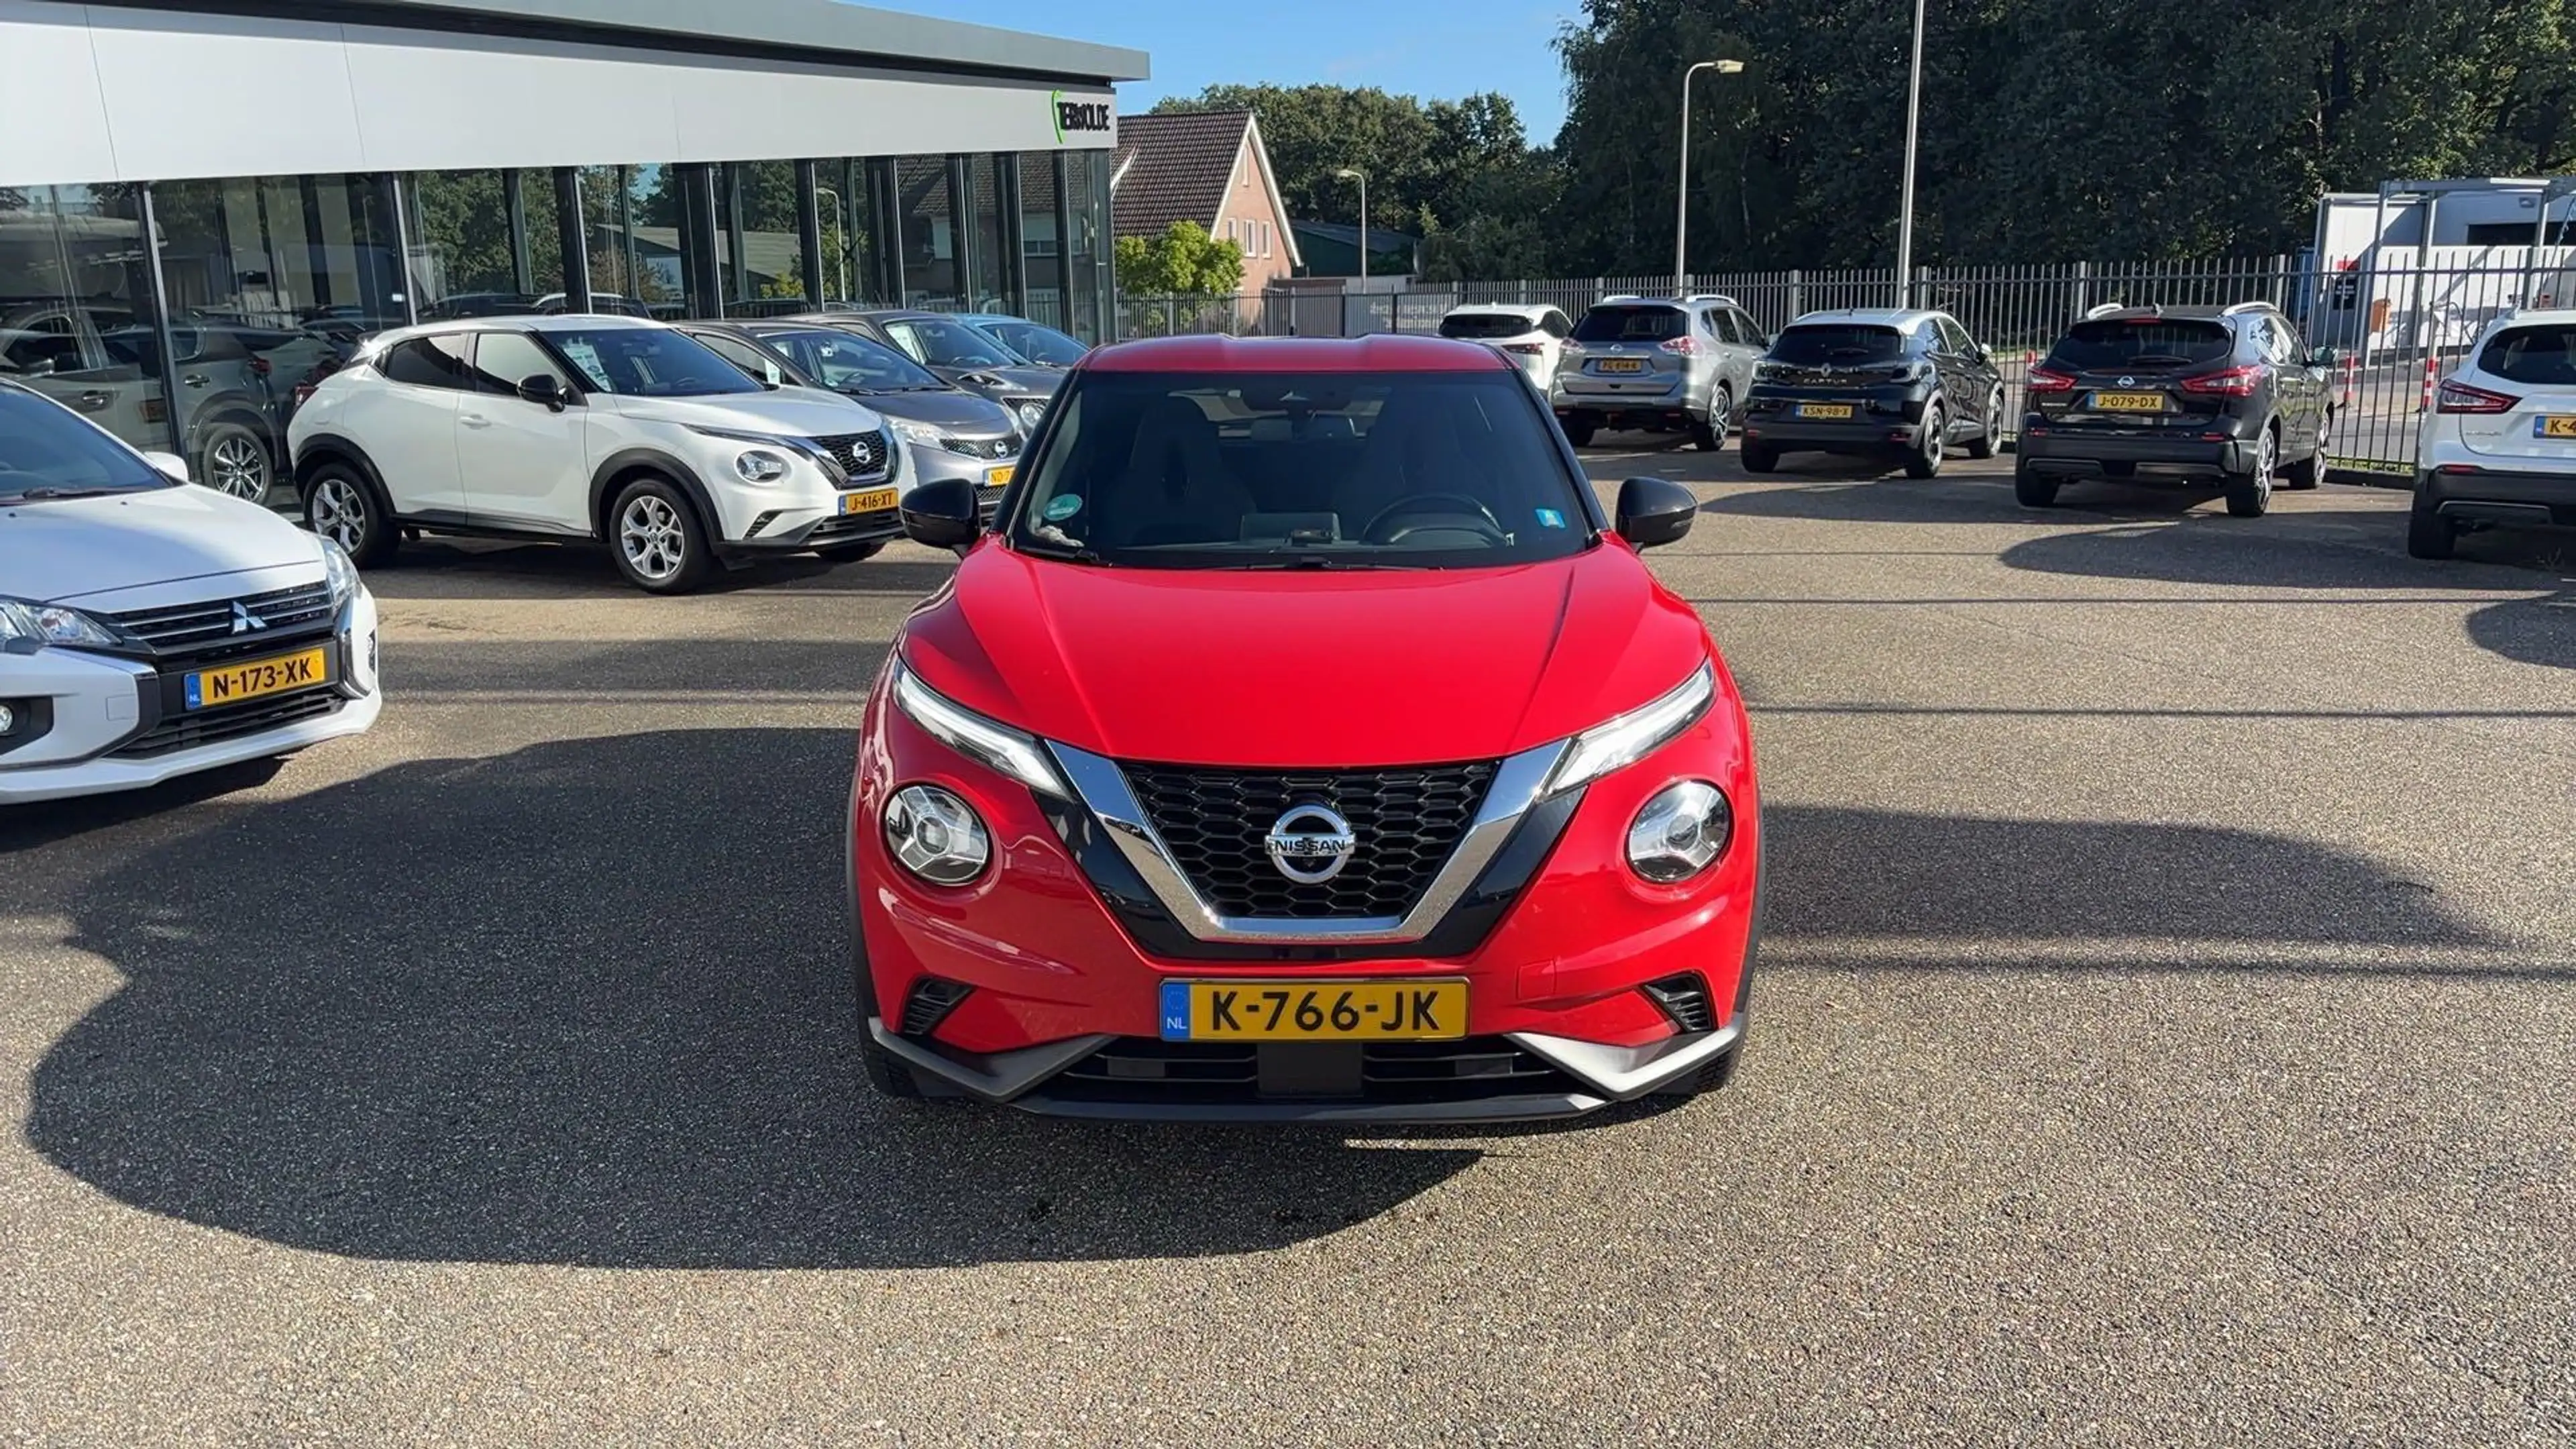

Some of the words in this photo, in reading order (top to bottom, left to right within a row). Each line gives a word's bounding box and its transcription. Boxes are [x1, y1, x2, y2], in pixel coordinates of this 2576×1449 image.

[2100, 396, 2157, 407] J-079-DX
[851, 492, 893, 511] J-416-XT
[213, 657, 312, 698] N-173-XK
[1275, 840, 1345, 851] NISSAN
[1212, 991, 1440, 1031] K-766-JK
[1167, 1017, 1187, 1029] NL
